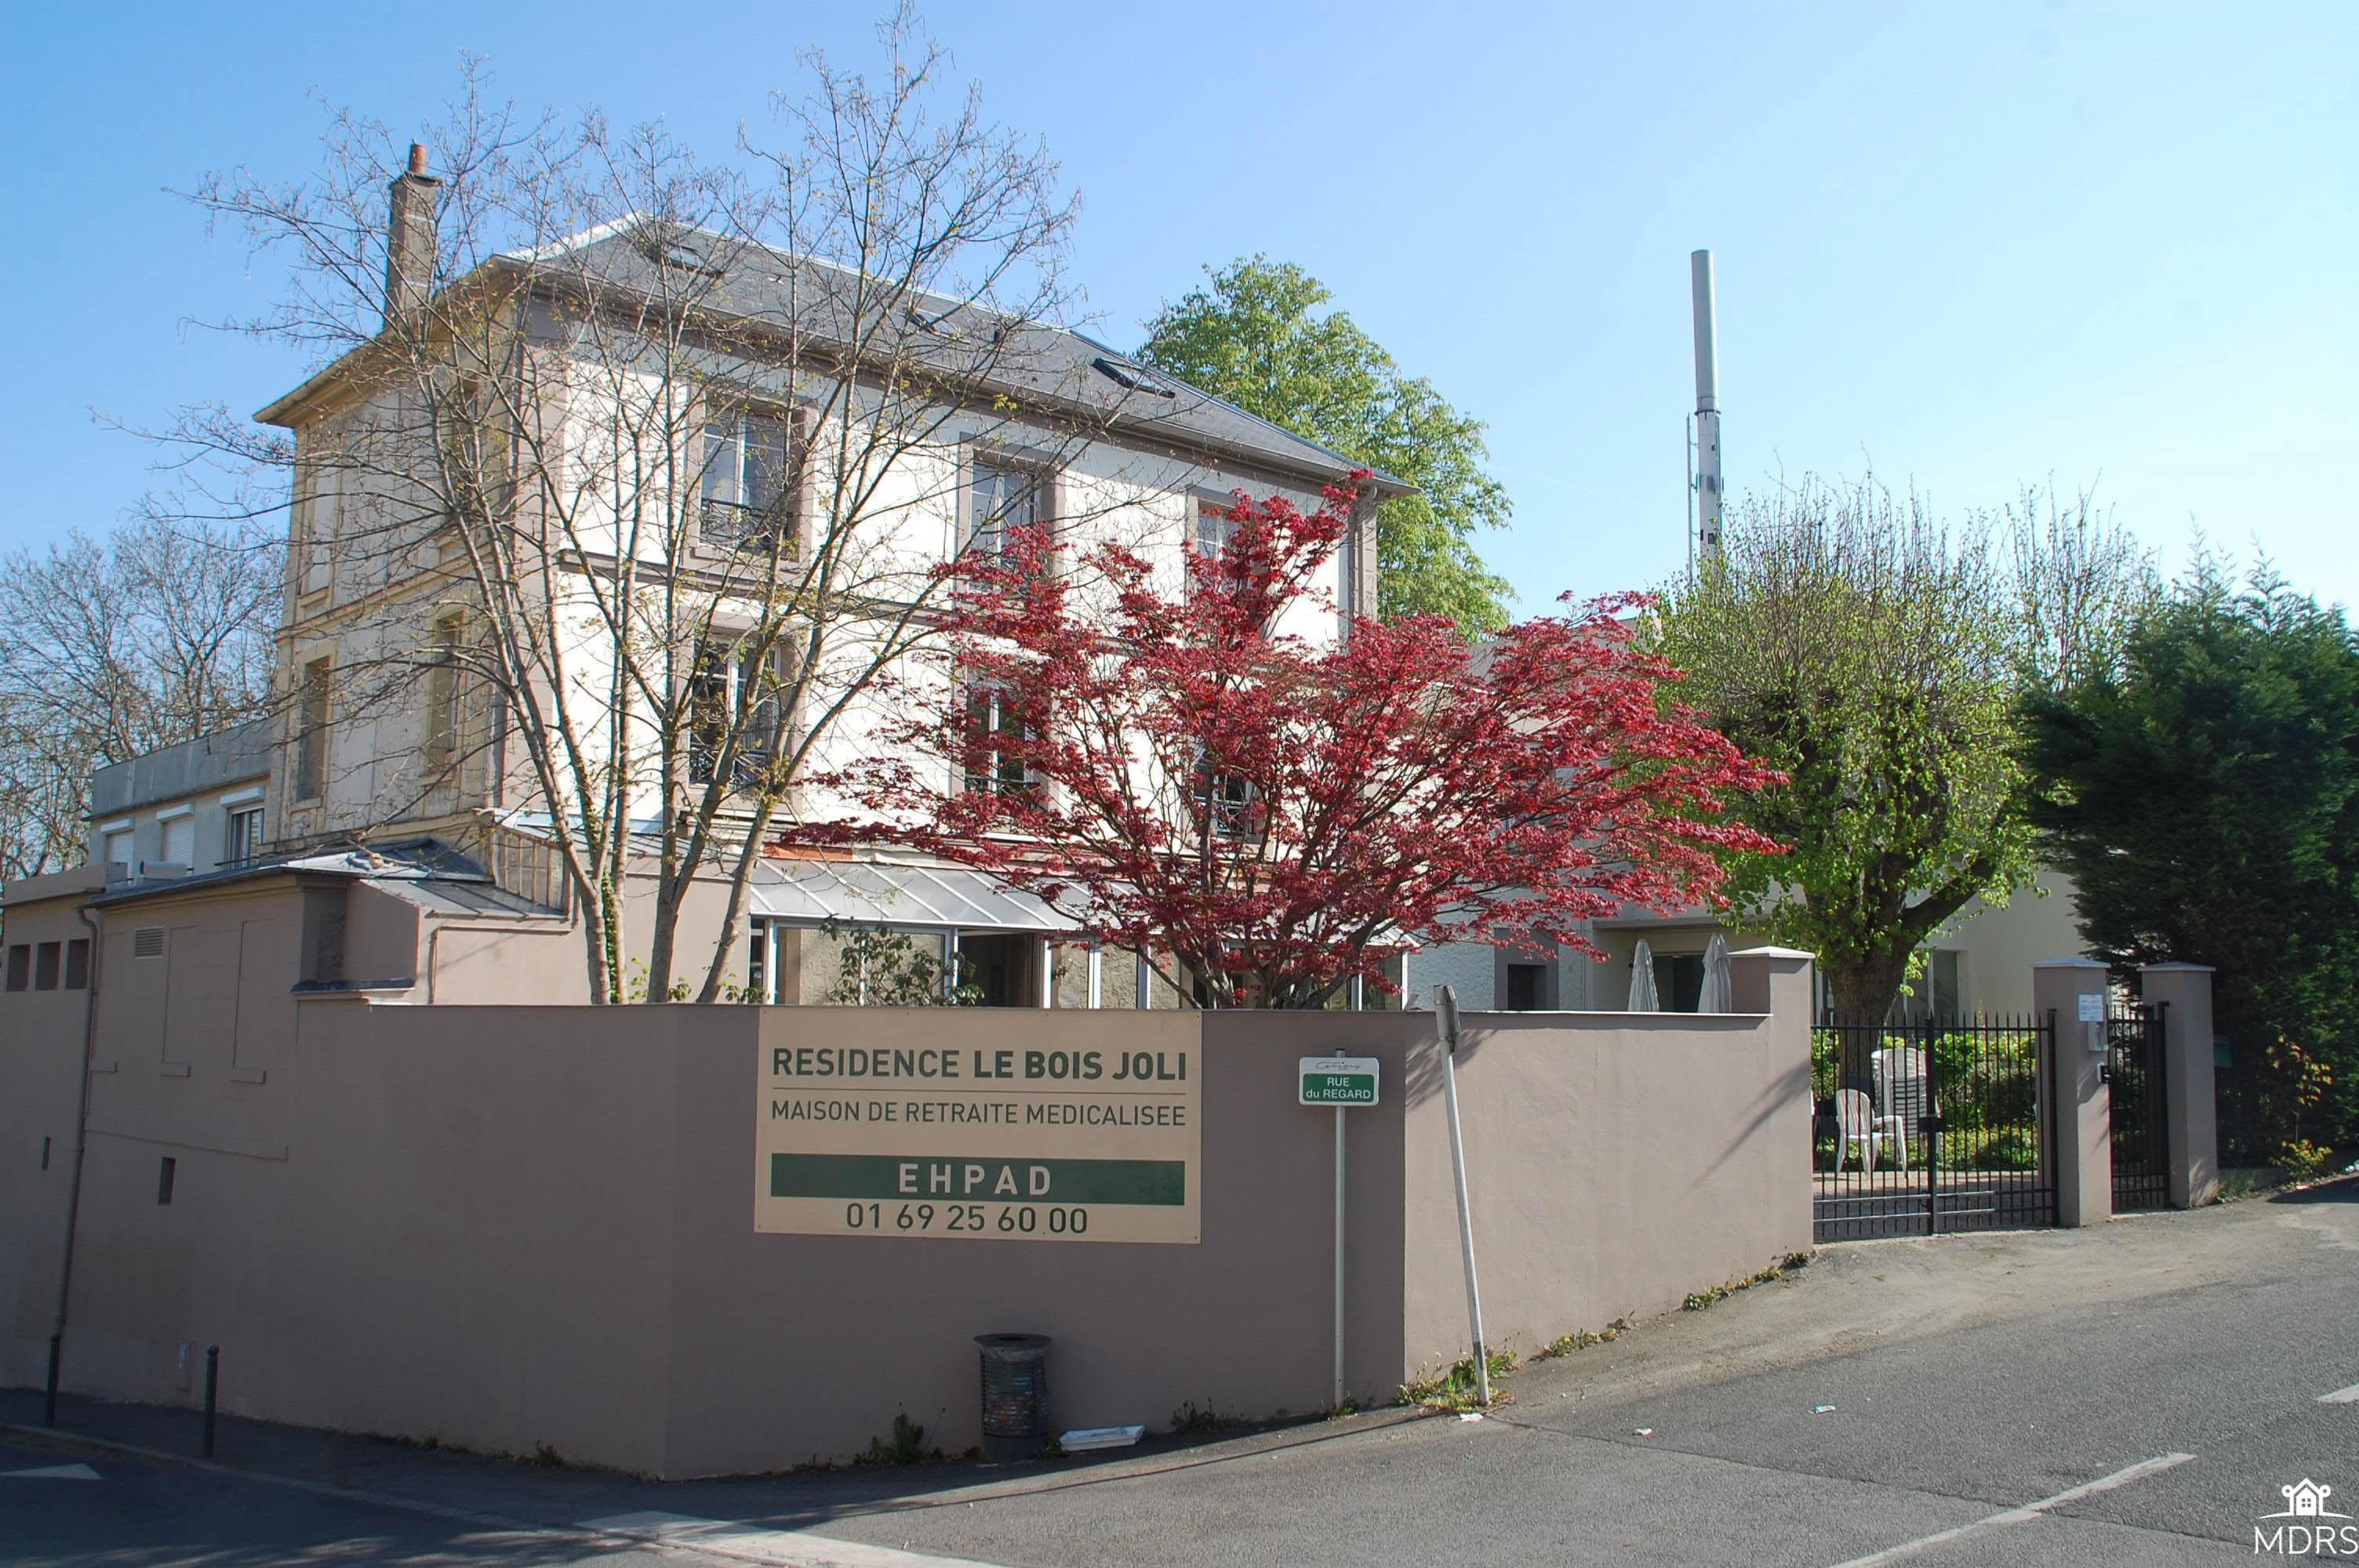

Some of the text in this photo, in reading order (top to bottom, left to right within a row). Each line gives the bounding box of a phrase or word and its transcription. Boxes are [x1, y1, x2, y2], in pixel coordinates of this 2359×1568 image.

[773, 1047, 1187, 1081] RESIDENCE LE BOIS JOLI
[1306, 1089, 1371, 1099] du REGARD
[1327, 1077, 1350, 1087] RUE
[772, 1100, 1186, 1127] MAISON DE RETRAITE MEDICALISEE
[899, 1163, 1051, 1196] EHPAD
[846, 1203, 1088, 1234] 01 69 25 60 00
